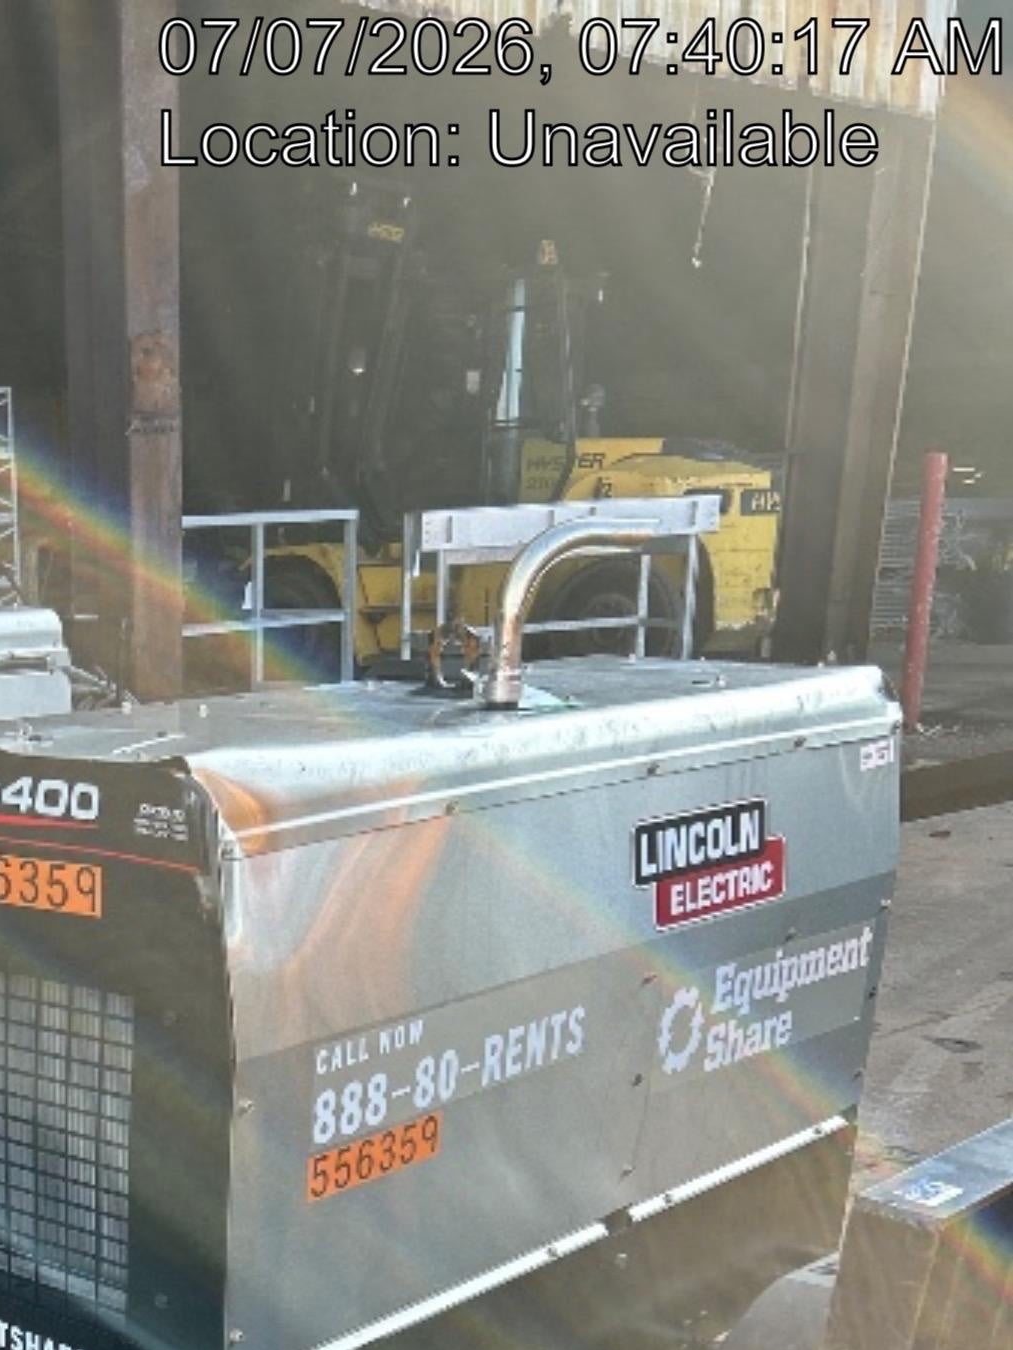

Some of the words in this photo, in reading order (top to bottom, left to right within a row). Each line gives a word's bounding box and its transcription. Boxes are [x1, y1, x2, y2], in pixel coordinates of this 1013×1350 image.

[640, 810, 760, 877] LINCOLN
[670, 860, 774, 916] ELECTRIC
[710, 926, 873, 1016] Equipment
[313, 1005, 585, 1145] 888-80-RENTS
[315, 1038, 369, 1075] CALL
[379, 1019, 424, 1053] NOW
[703, 1010, 793, 1073] Share
[310, 1114, 439, 1197] 556359
